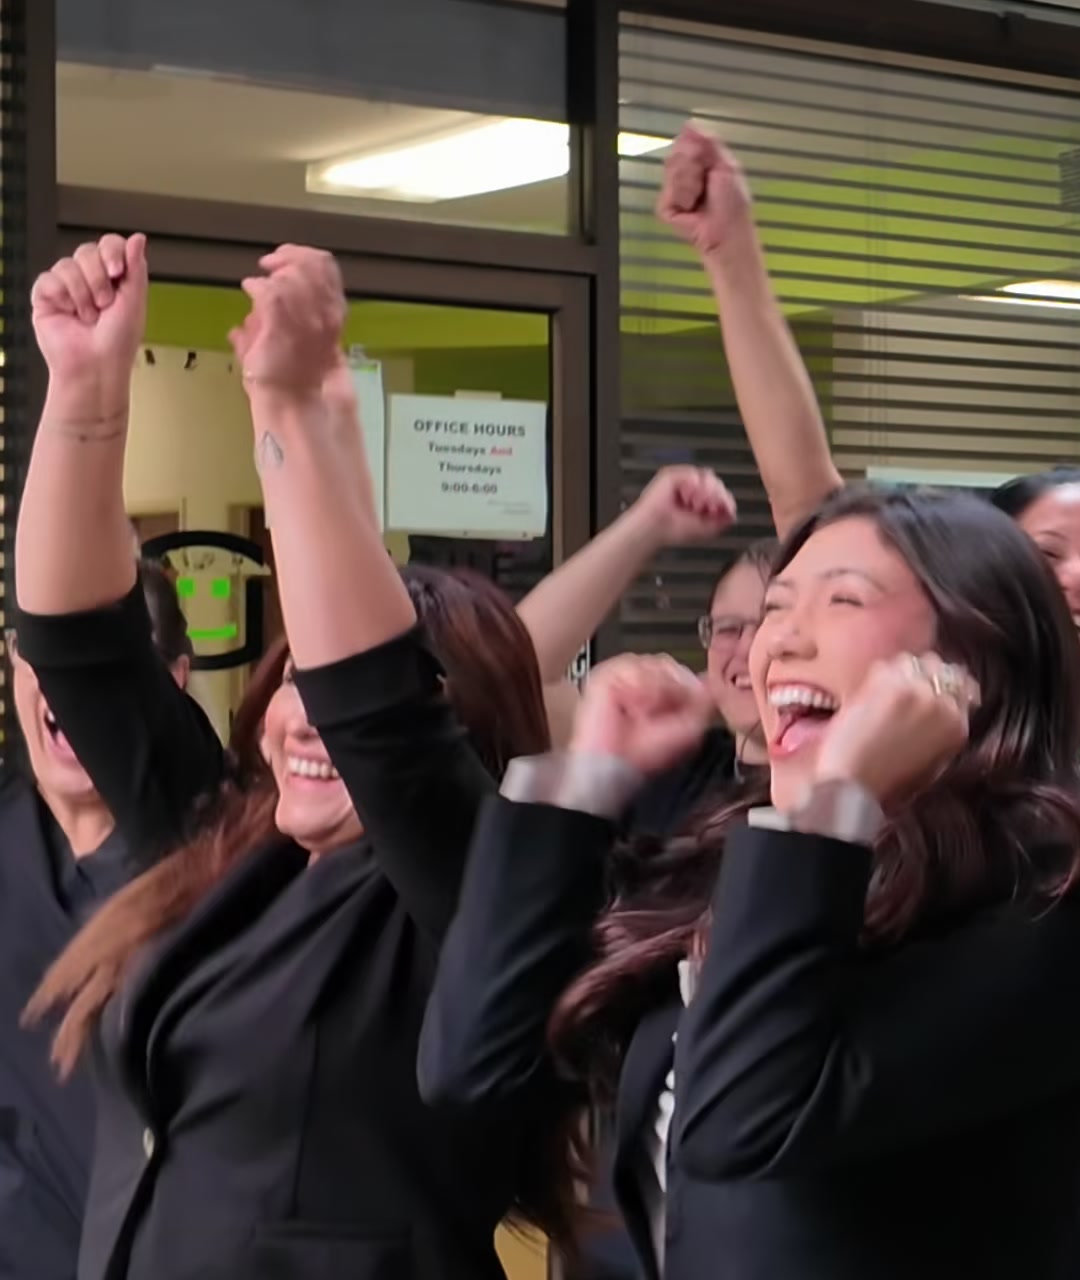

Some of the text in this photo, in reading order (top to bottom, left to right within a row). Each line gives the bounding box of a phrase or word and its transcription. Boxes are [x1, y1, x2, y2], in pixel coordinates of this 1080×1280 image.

[413, 419, 526, 437] OFFICE HOURS
[428, 441, 486, 457] Tuesdays
[439, 461, 502, 476] Thursdays
